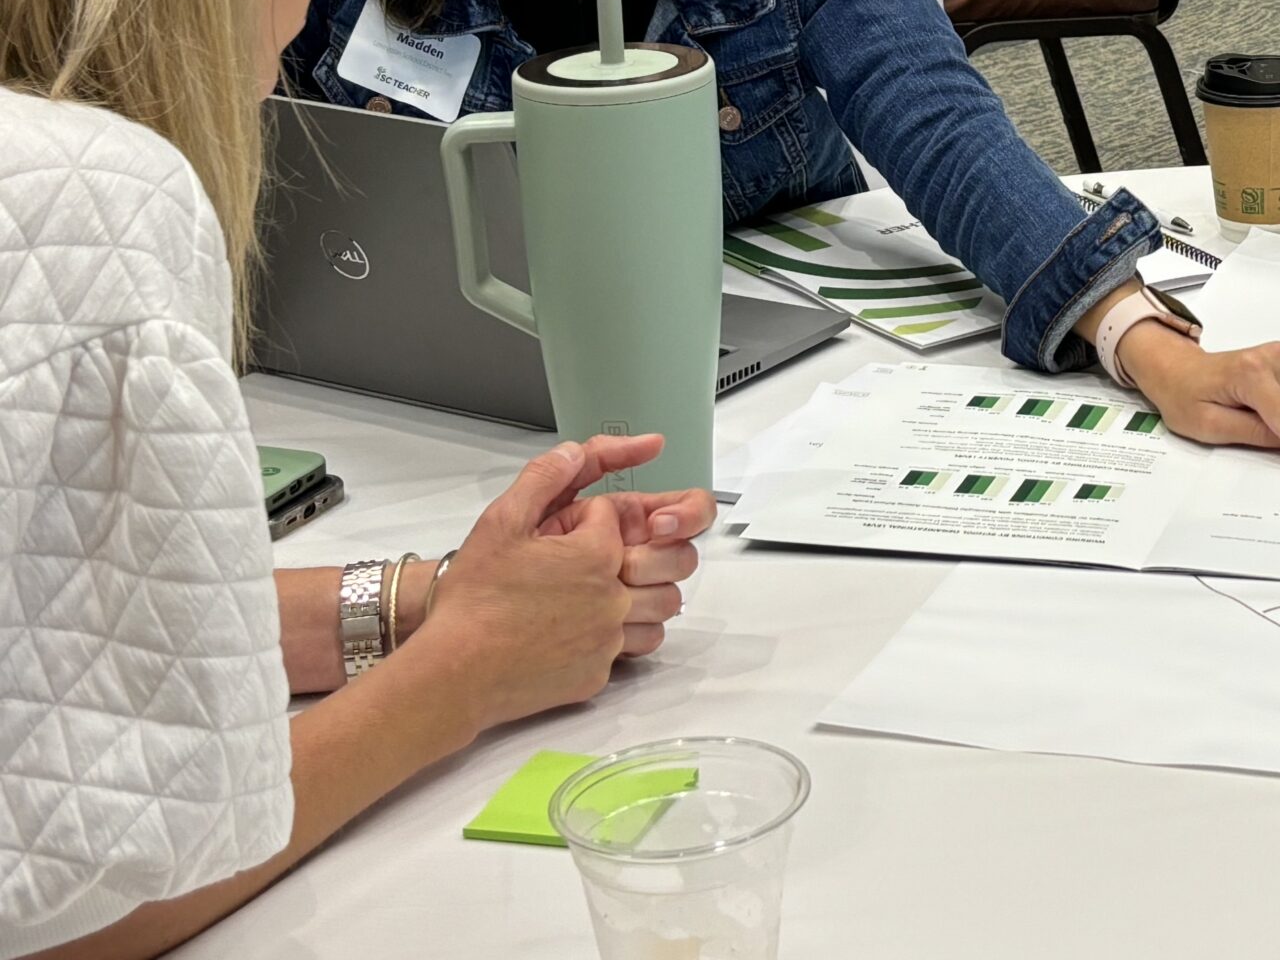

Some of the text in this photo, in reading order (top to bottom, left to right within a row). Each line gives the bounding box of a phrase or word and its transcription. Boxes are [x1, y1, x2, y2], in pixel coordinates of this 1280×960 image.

[396, 32, 444, 59] Madden
[380, 74, 430, 100] SC TEACHER
